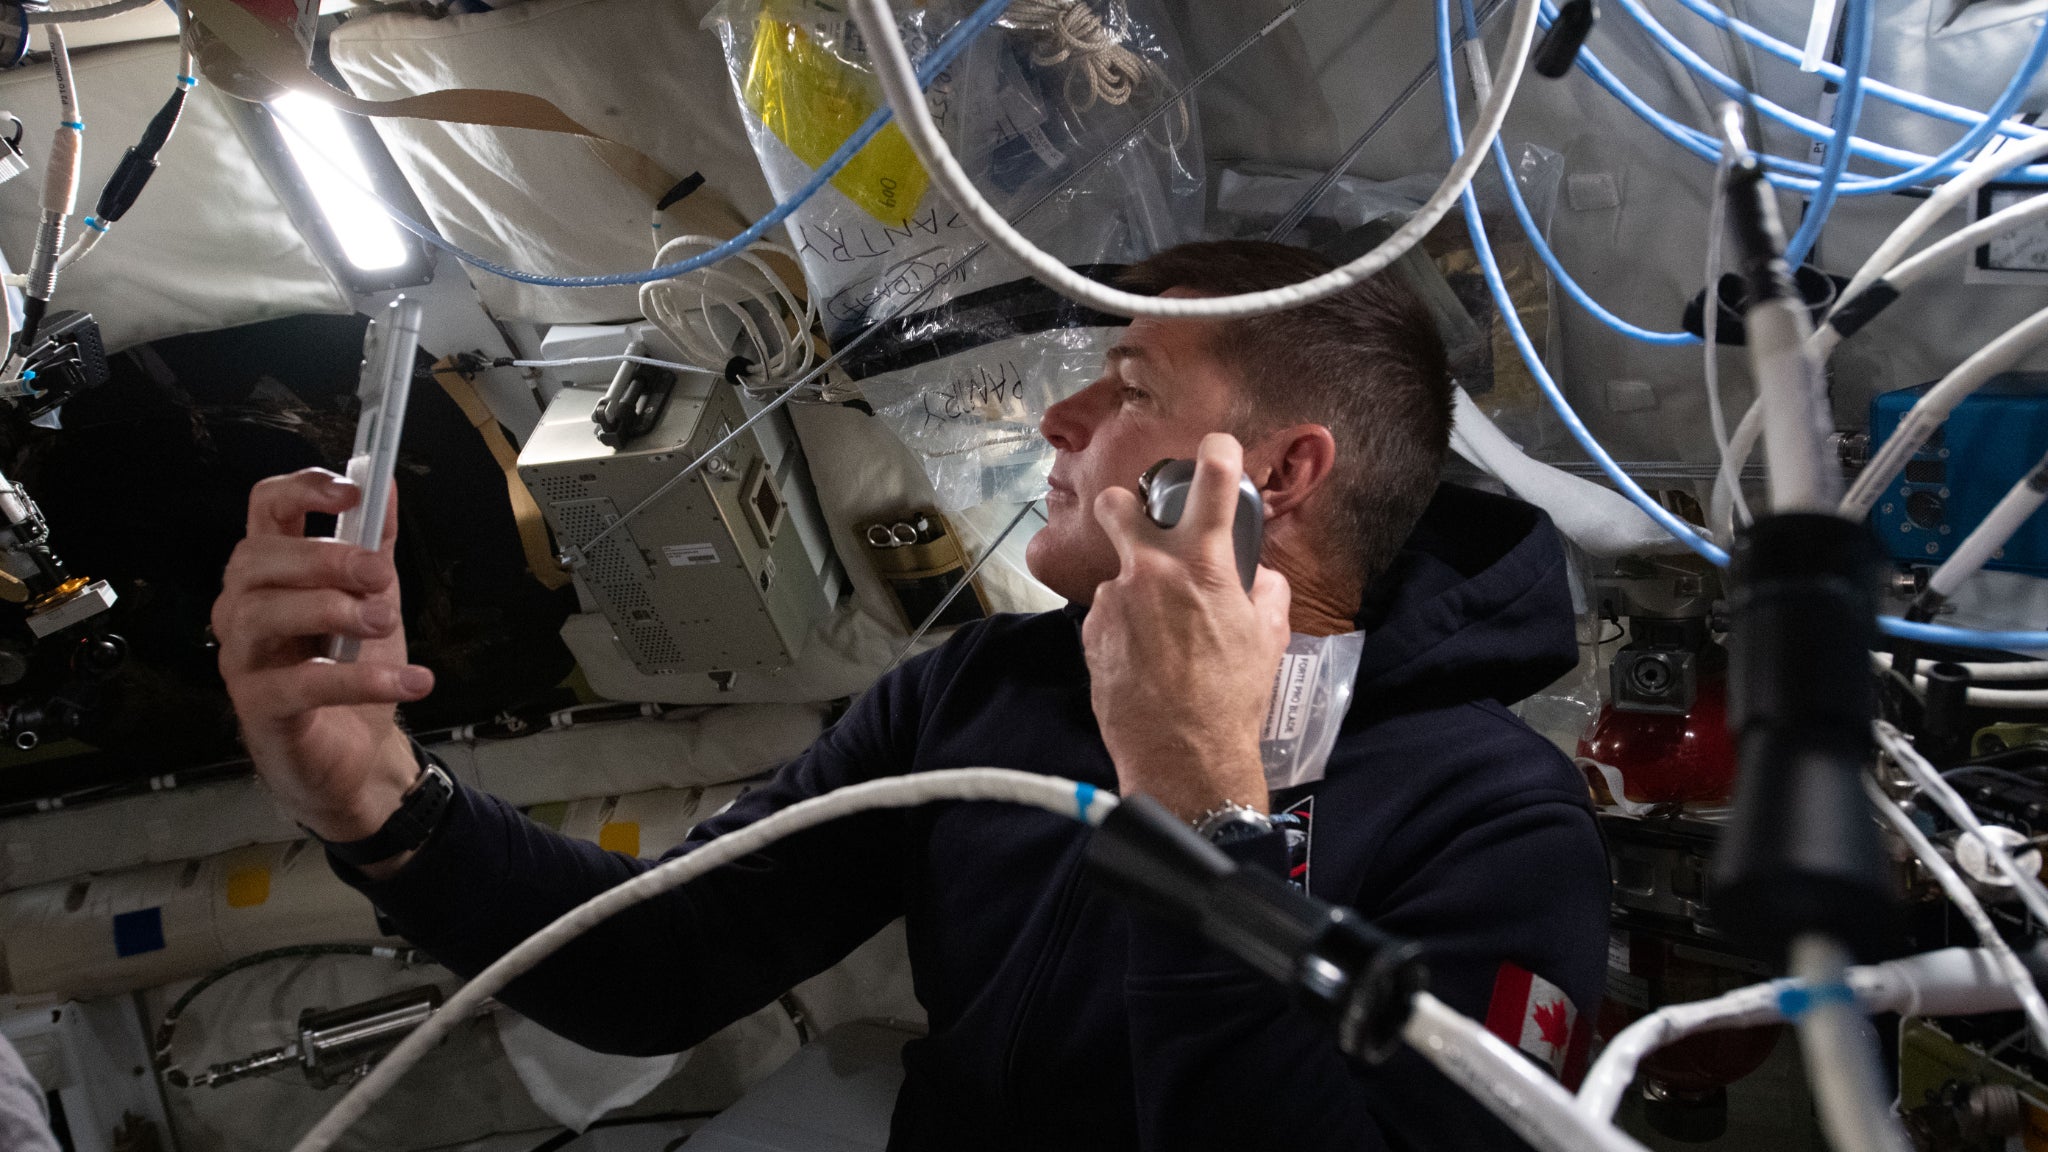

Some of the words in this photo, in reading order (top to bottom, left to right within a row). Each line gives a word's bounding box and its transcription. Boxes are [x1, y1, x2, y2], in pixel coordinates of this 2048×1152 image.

[53, 57, 63, 82] ORION
[58, 83, 67, 93] TO
[61, 95, 69, 106] P2
[799, 208, 969, 264] PANTRY
[923, 360, 1024, 430] PANTRY
[1293, 657, 1309, 684] FORTE
[1290, 686, 1303, 703] PRO
[1284, 705, 1298, 734] BLADE
